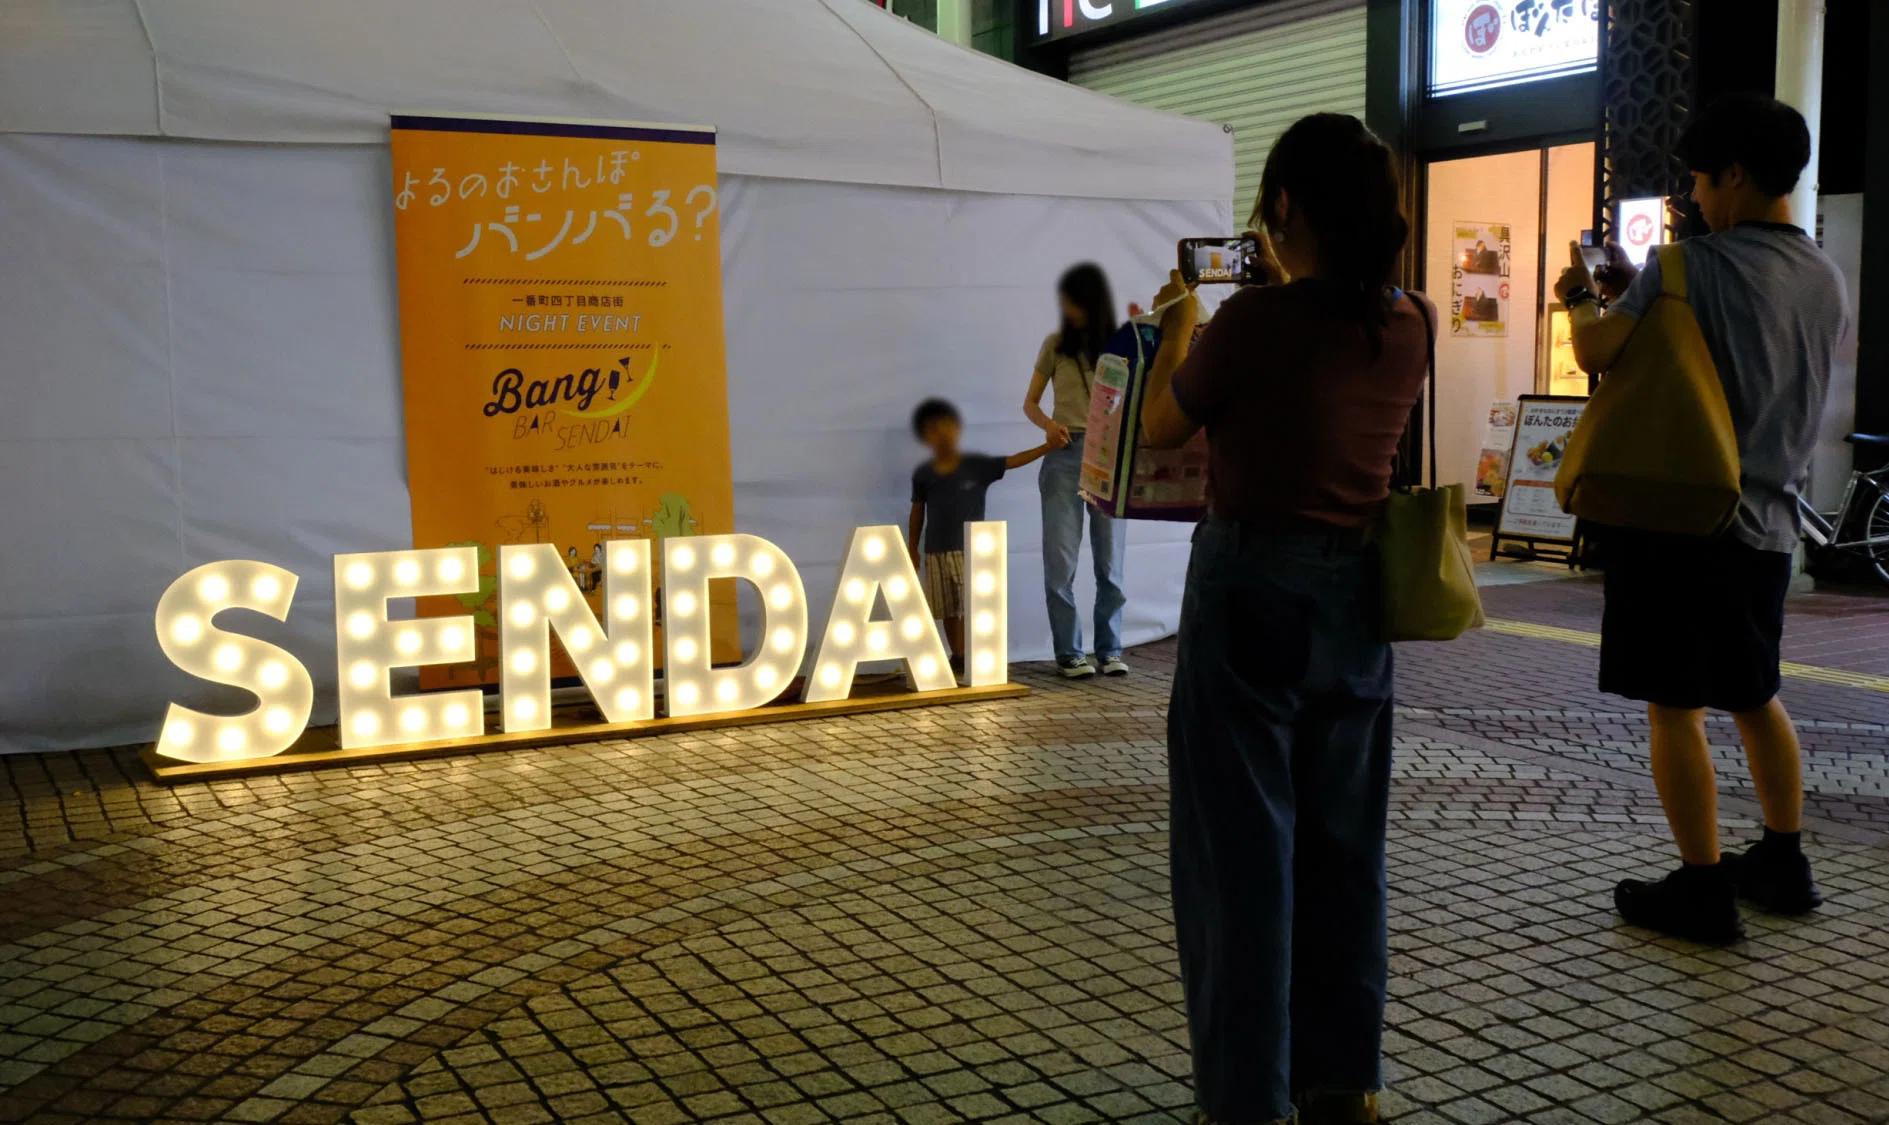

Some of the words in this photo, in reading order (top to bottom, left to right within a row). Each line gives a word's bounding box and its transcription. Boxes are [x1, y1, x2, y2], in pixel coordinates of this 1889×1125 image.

[396, 150, 641, 210] よるのおさんぽ
[1198, 268, 1233, 279] SENDAI
[511, 294, 624, 308] 一番町四丁目商店街
[499, 313, 570, 333] NIGHT
[576, 313, 643, 333] EVENT
[483, 367, 608, 417] Bang
[512, 410, 557, 441] BAR
[552, 414, 633, 451] SENDAI
[155, 520, 1008, 763] SENDAI
